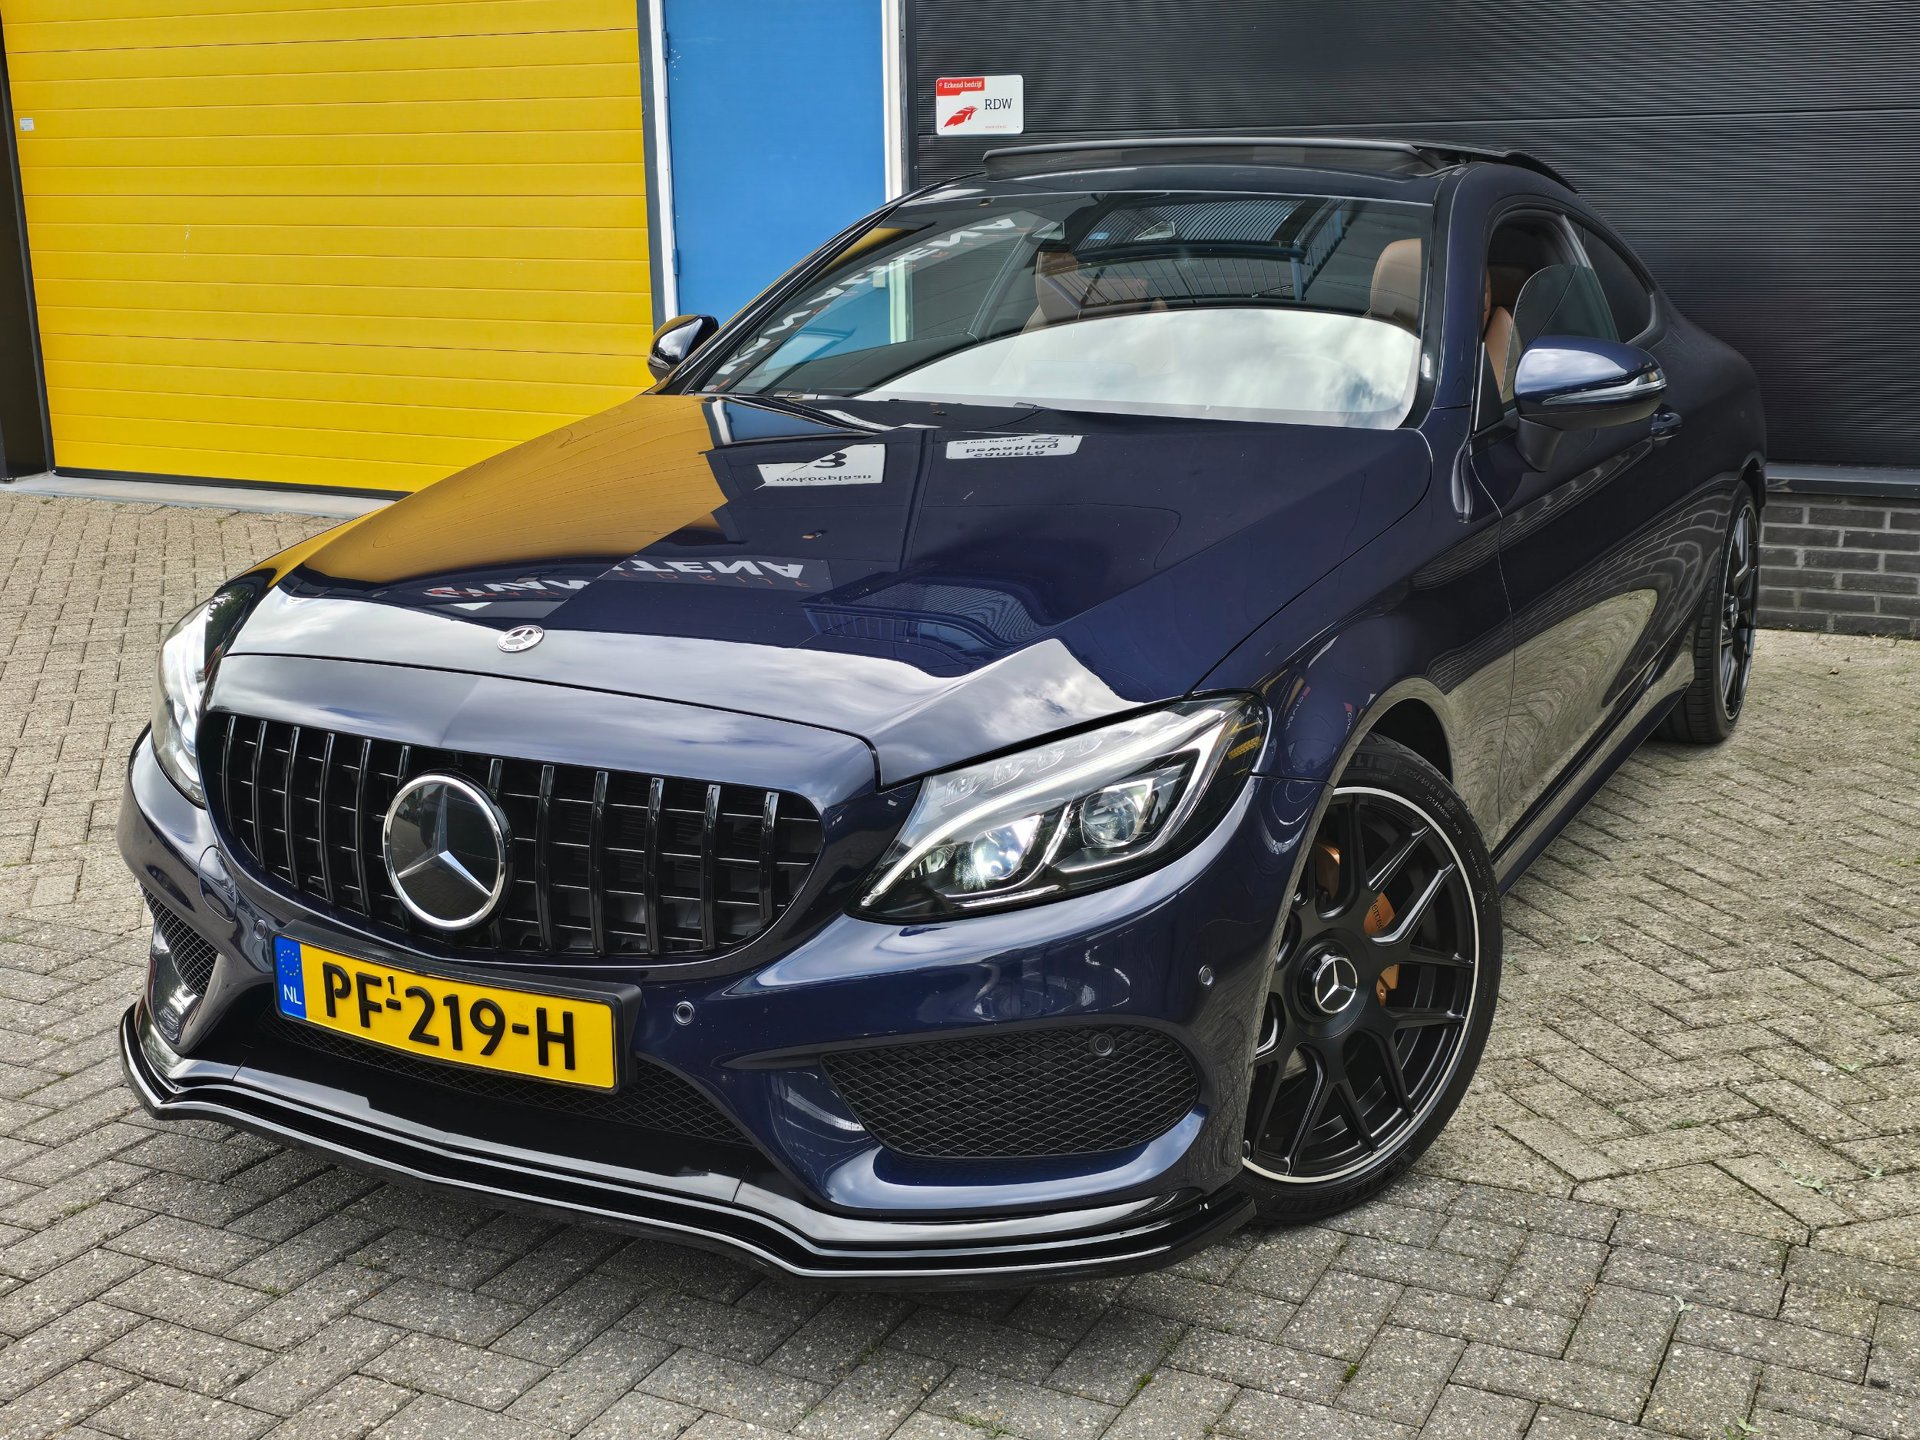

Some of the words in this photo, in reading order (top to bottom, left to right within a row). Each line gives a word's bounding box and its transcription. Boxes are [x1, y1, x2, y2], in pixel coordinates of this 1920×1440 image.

[943, 81, 964, 89] Erkend
[964, 80, 983, 89] bedrijf
[984, 97, 1013, 110] RDW
[283, 983, 302, 1006] NL
[322, 961, 576, 1071] PF-219-H
